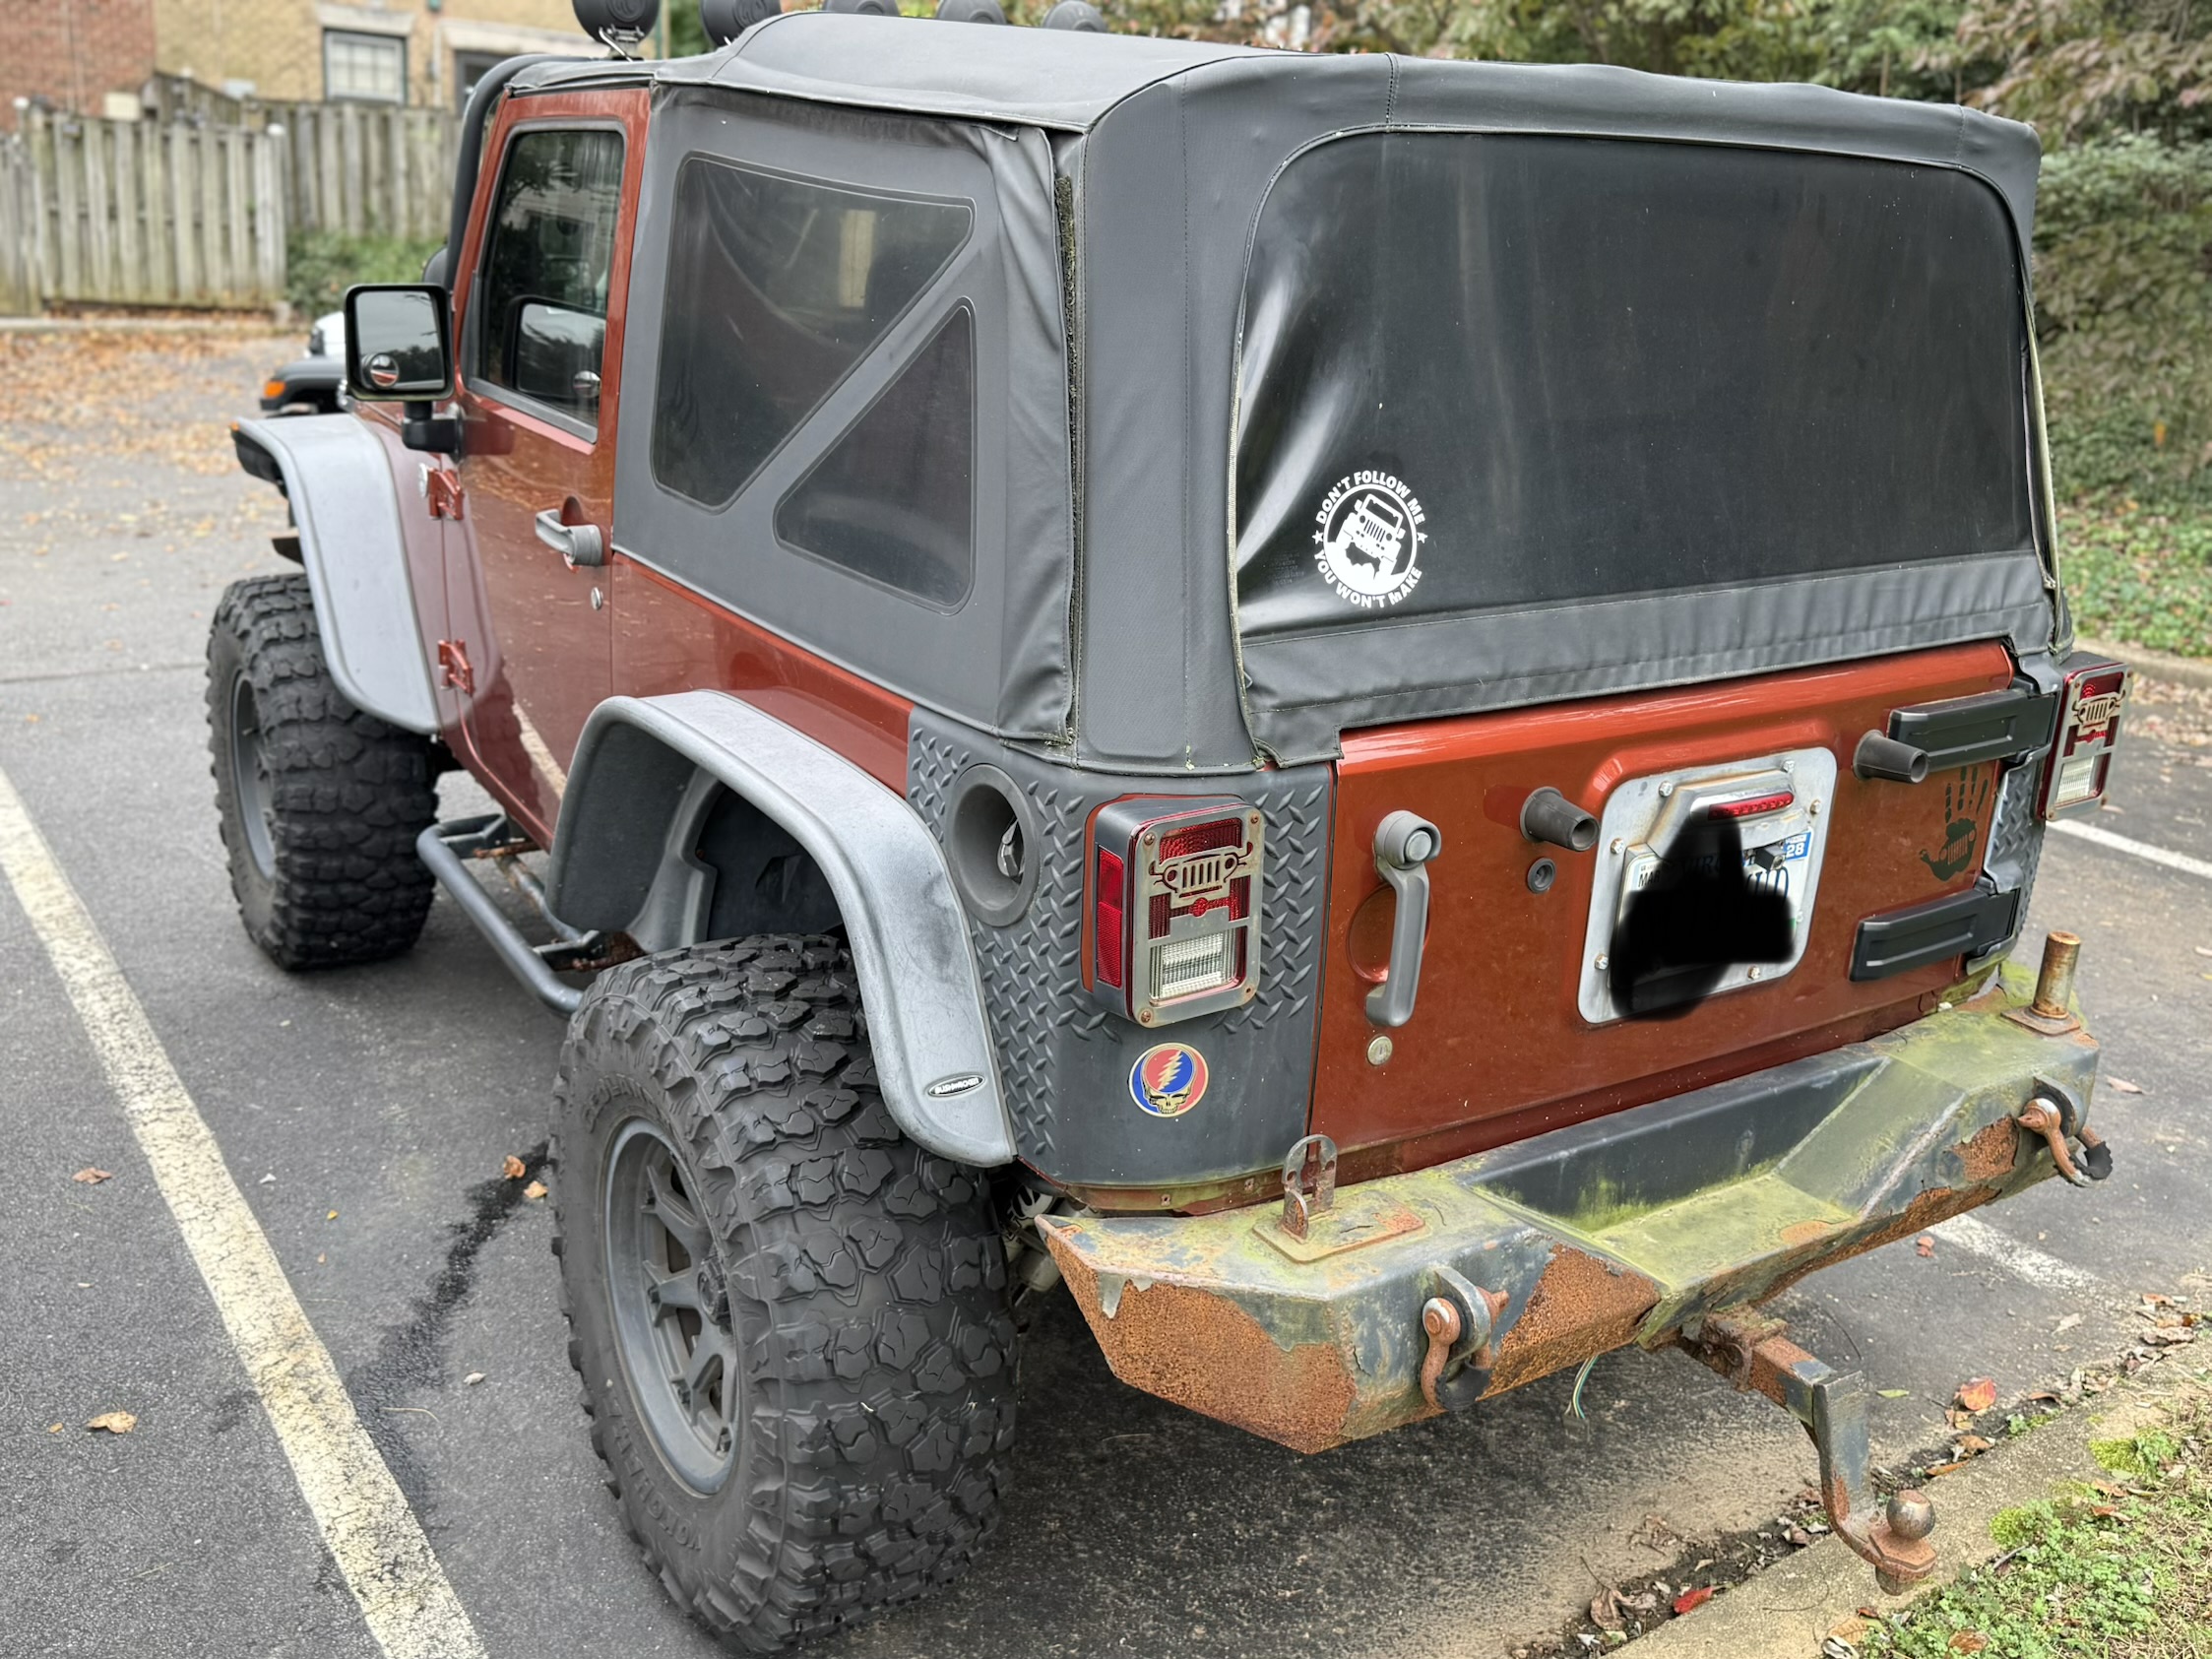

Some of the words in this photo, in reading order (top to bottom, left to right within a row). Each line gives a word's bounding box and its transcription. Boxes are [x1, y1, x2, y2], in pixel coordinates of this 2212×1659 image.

[1315, 477, 1351, 525] DON'T
[1354, 470, 1412, 499] FOLLOW
[1407, 497, 1426, 525] ME
[1314, 549, 1337, 585] YOU
[1336, 582, 1386, 608] WON'T
[1388, 566, 1423, 606] MAKE
[1786, 842, 1805, 859] 28
